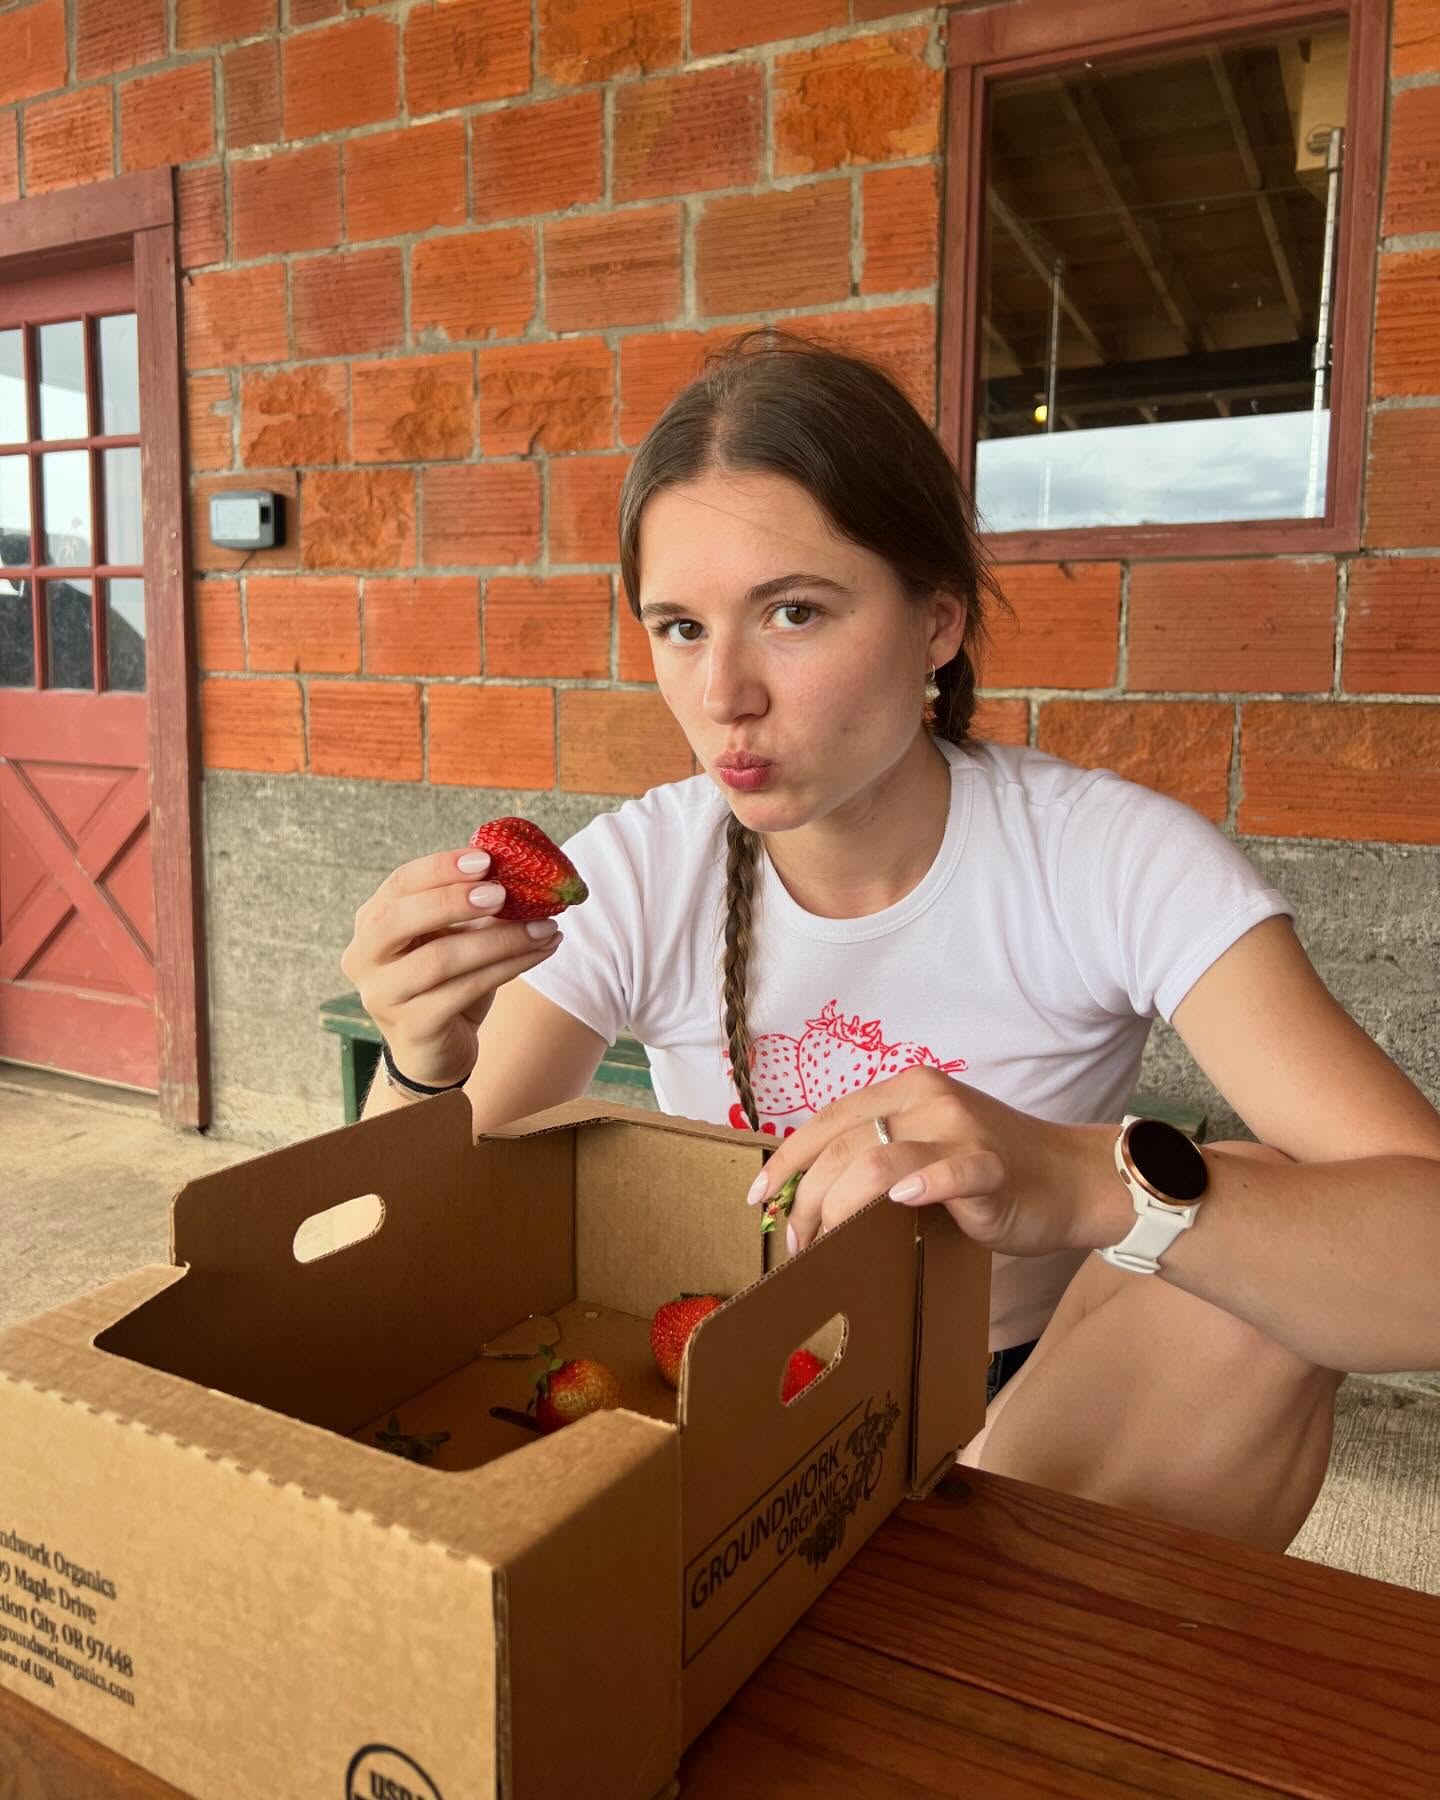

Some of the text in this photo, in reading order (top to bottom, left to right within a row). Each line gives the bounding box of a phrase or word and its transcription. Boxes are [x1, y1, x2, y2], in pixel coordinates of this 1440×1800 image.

[690, 1439, 840, 1609] GROUNDWORK
[776, 1464, 849, 1555] ORGANICS
[14, 1565, 57, 1604] Maple
[59, 1587, 97, 1625] Drive
[53, 1551, 117, 1600] Organics
[0, 1593, 134, 1678] tion City, OR 97448
[20, 1657, 32, 1675] of
[33, 1663, 56, 1688] USA
[370, 1769, 427, 1800] USD
